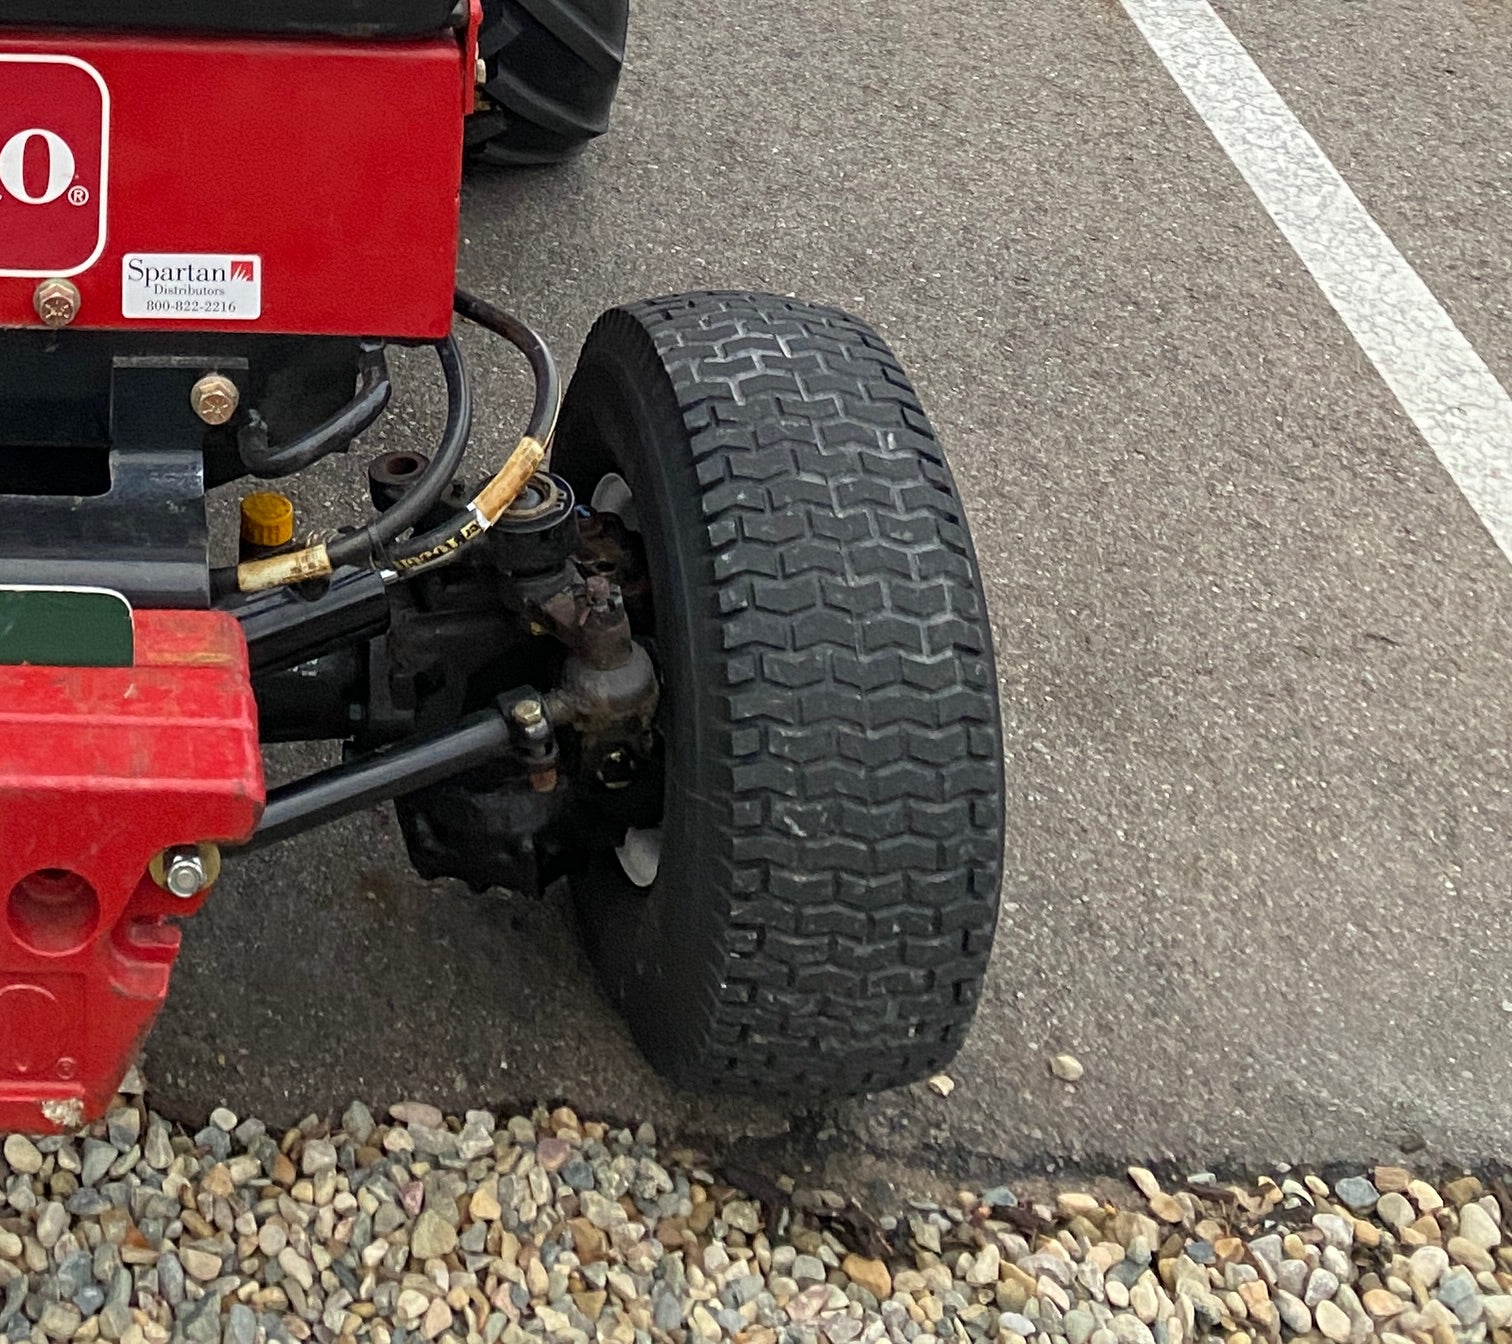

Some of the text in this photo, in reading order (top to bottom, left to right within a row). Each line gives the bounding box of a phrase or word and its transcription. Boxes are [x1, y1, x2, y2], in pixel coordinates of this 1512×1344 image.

[128, 258, 226, 288] Spartan
[154, 283, 225, 296] Distributors
[146, 300, 236, 313] 800-822-2216
